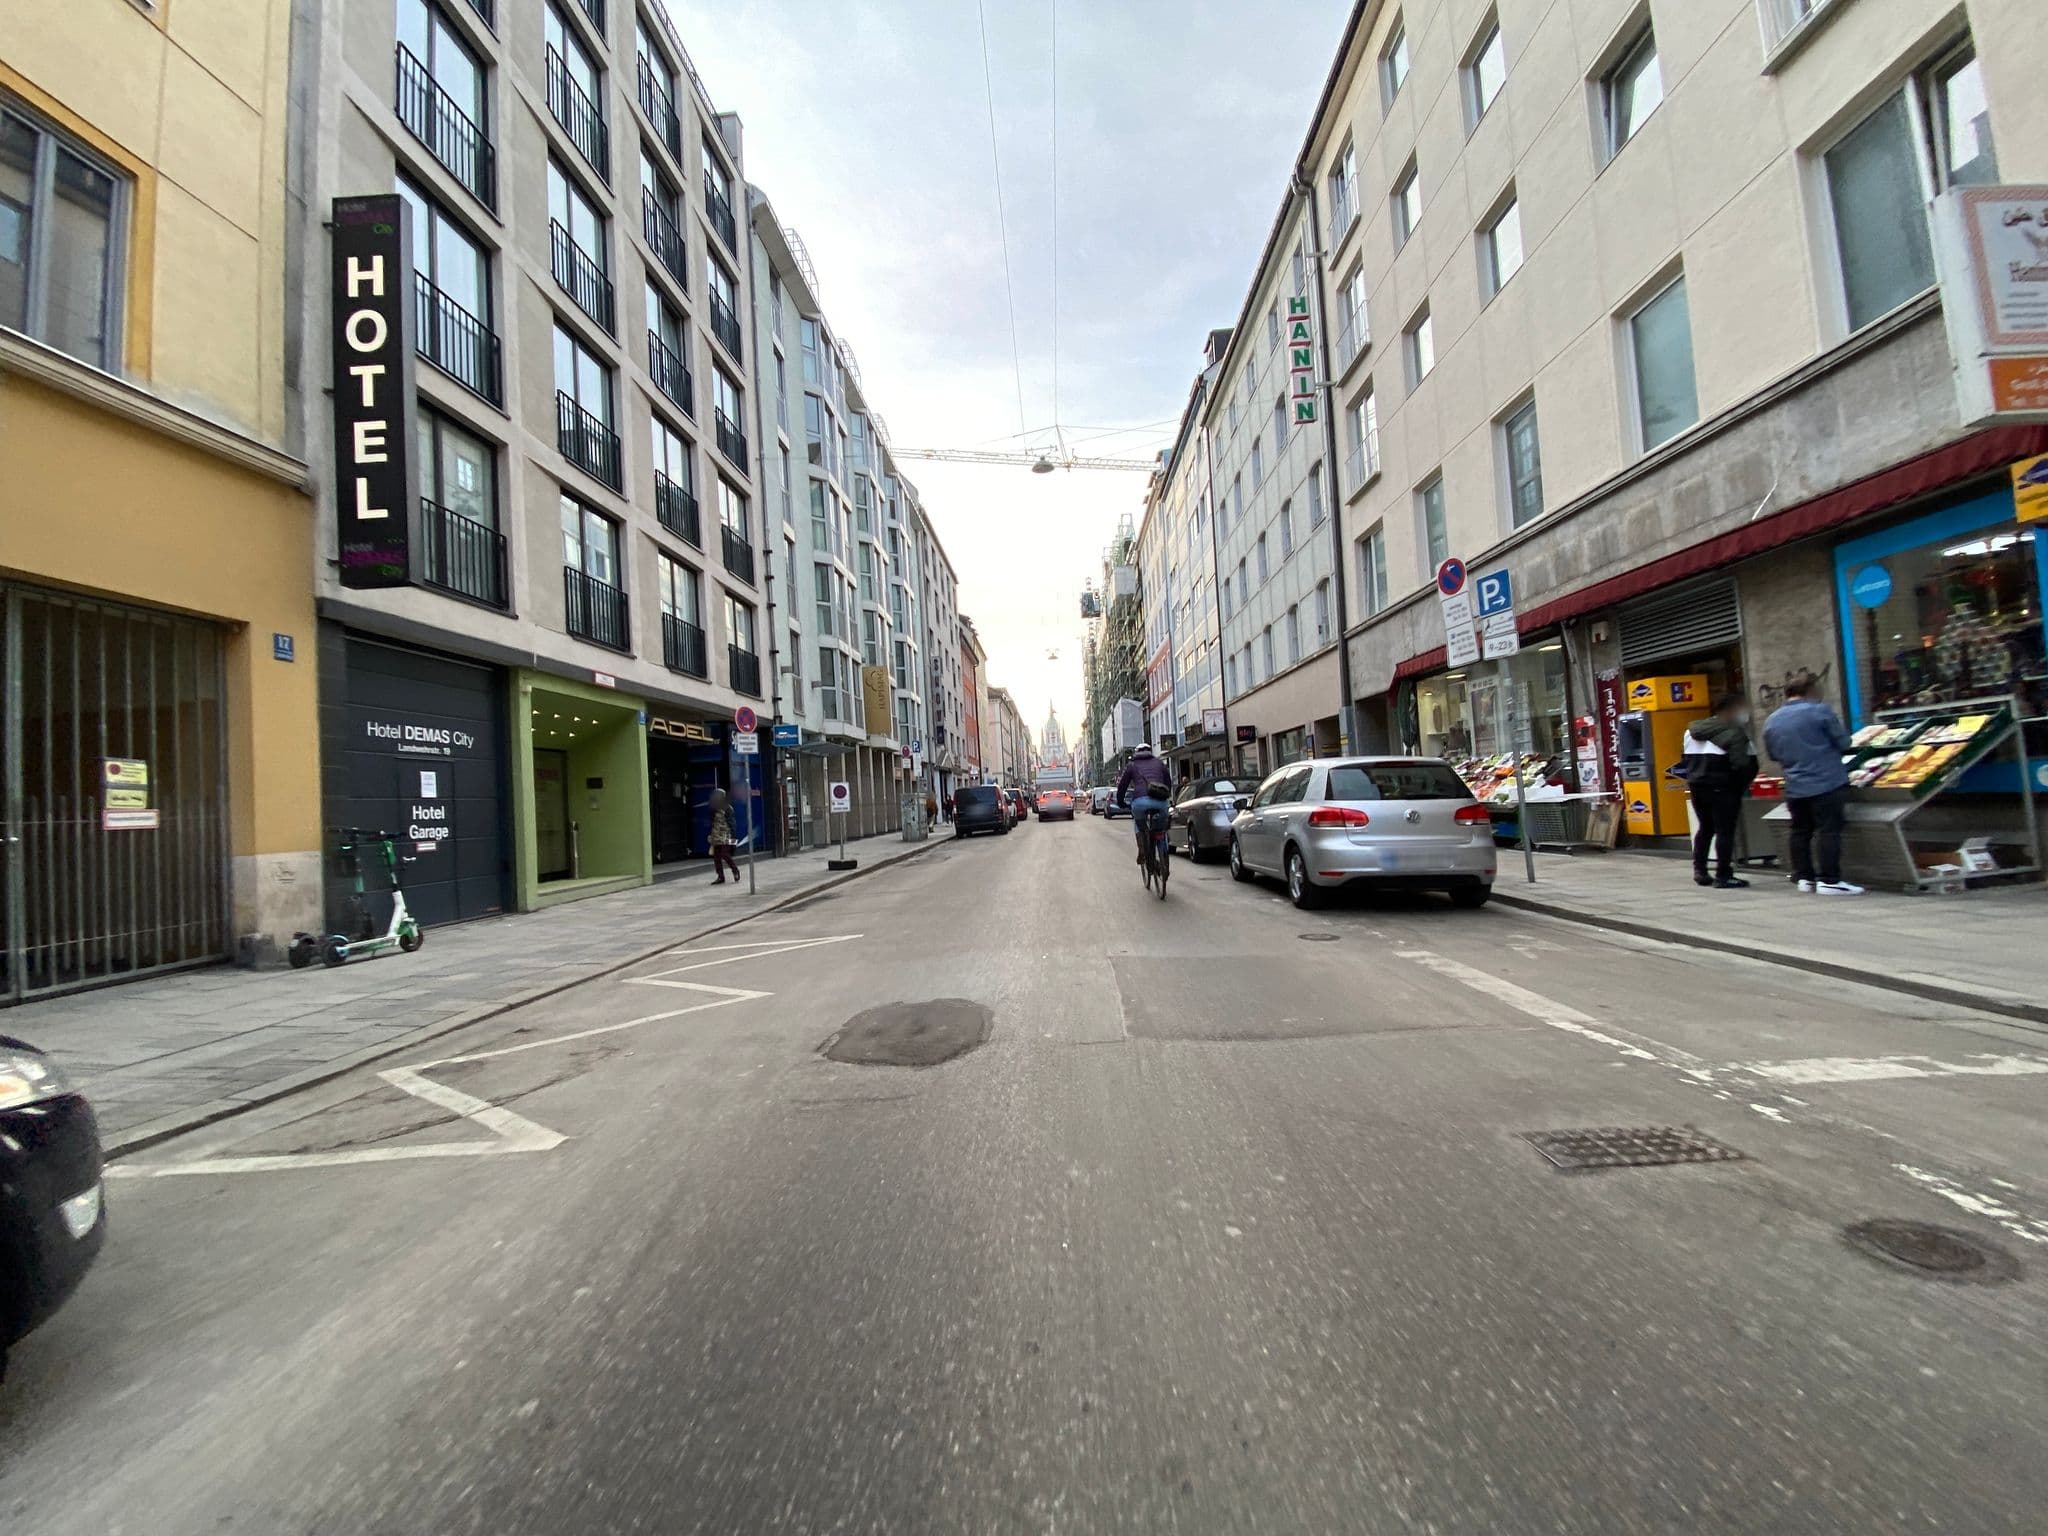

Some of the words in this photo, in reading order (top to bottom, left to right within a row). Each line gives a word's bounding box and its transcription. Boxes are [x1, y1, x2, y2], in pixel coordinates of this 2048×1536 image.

[1290, 297, 1314, 420] HANIN
[346, 255, 389, 520] HOTEL
[279, 636, 290, 650] 17
[367, 721, 401, 739] Hotel
[404, 725, 450, 744] DEMAS
[453, 731, 474, 748] City
[649, 717, 714, 742] ADEL
[412, 805, 445, 820] Hotel
[409, 824, 449, 840] Garage
